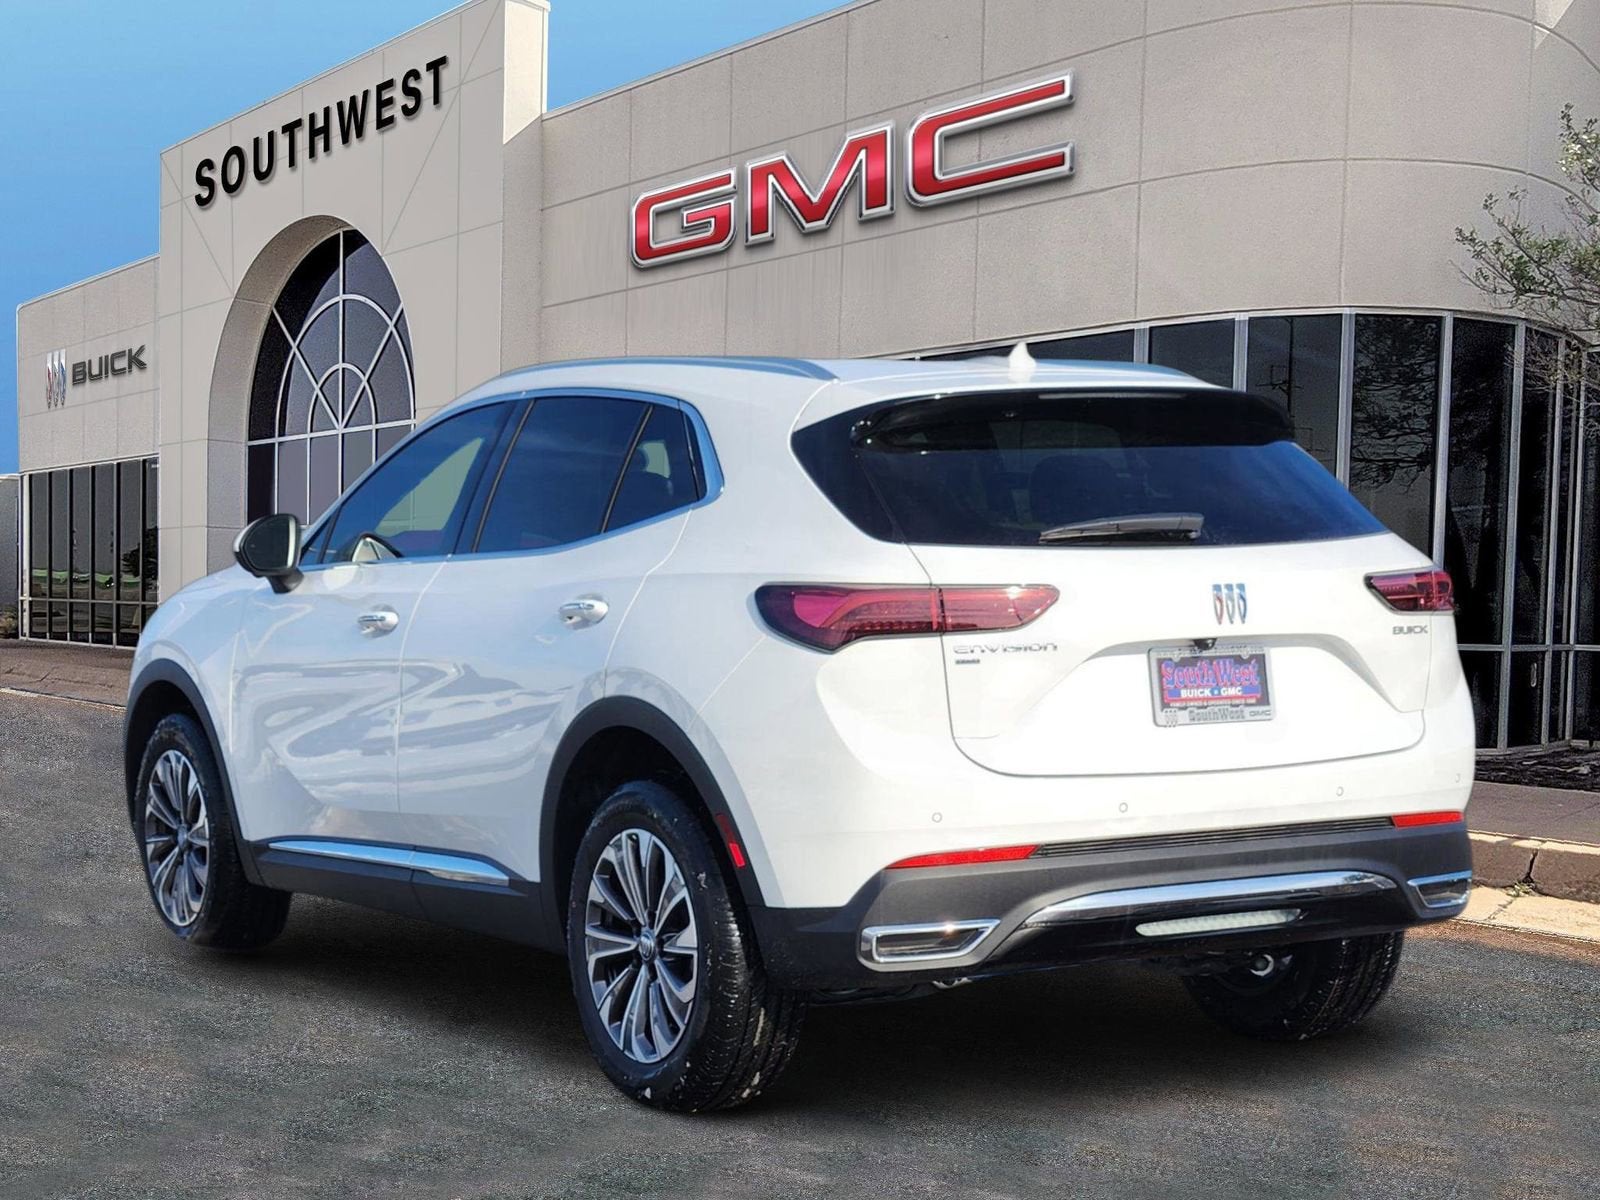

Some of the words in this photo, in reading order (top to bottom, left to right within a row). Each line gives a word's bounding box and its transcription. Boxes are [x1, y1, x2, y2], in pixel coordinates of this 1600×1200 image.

[195, 55, 448, 207] SOUTHWEST
[630, 69, 1075, 268] GMC
[72, 344, 147, 385] BUICK
[1392, 625, 1429, 635] BUICK
[1180, 687, 1212, 698] BUICK
[1220, 686, 1243, 696] GMC
